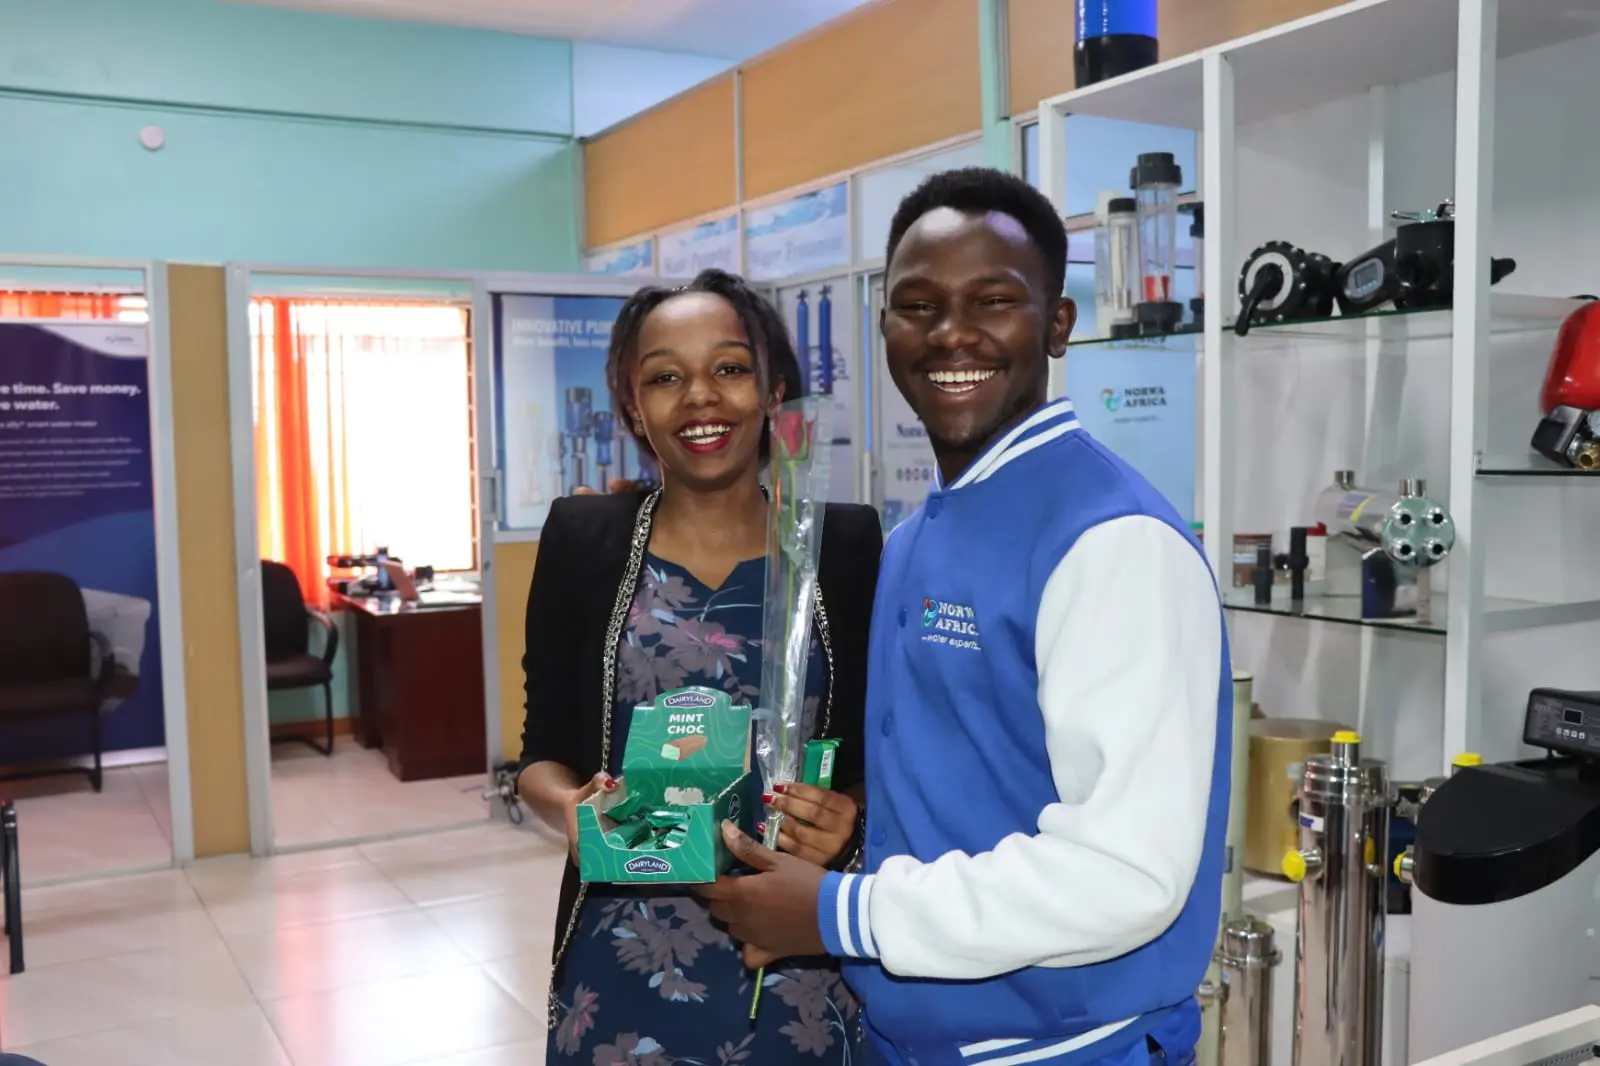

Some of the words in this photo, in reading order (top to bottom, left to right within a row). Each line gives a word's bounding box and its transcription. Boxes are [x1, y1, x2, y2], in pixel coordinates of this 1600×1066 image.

[12, 382, 51, 394] time.
[52, 382, 88, 394] Save
[89, 384, 142, 396] money.
[1124, 386, 1165, 397] NORWA
[13, 399, 60, 411] water.
[1124, 397, 1167, 408] AFRICA
[938, 601, 974, 619] NORW
[667, 695, 713, 704] DAIRYLAND
[669, 713, 705, 722] MINT
[667, 725, 705, 734] CHOC
[628, 860, 669, 870] DAIRYLAND
